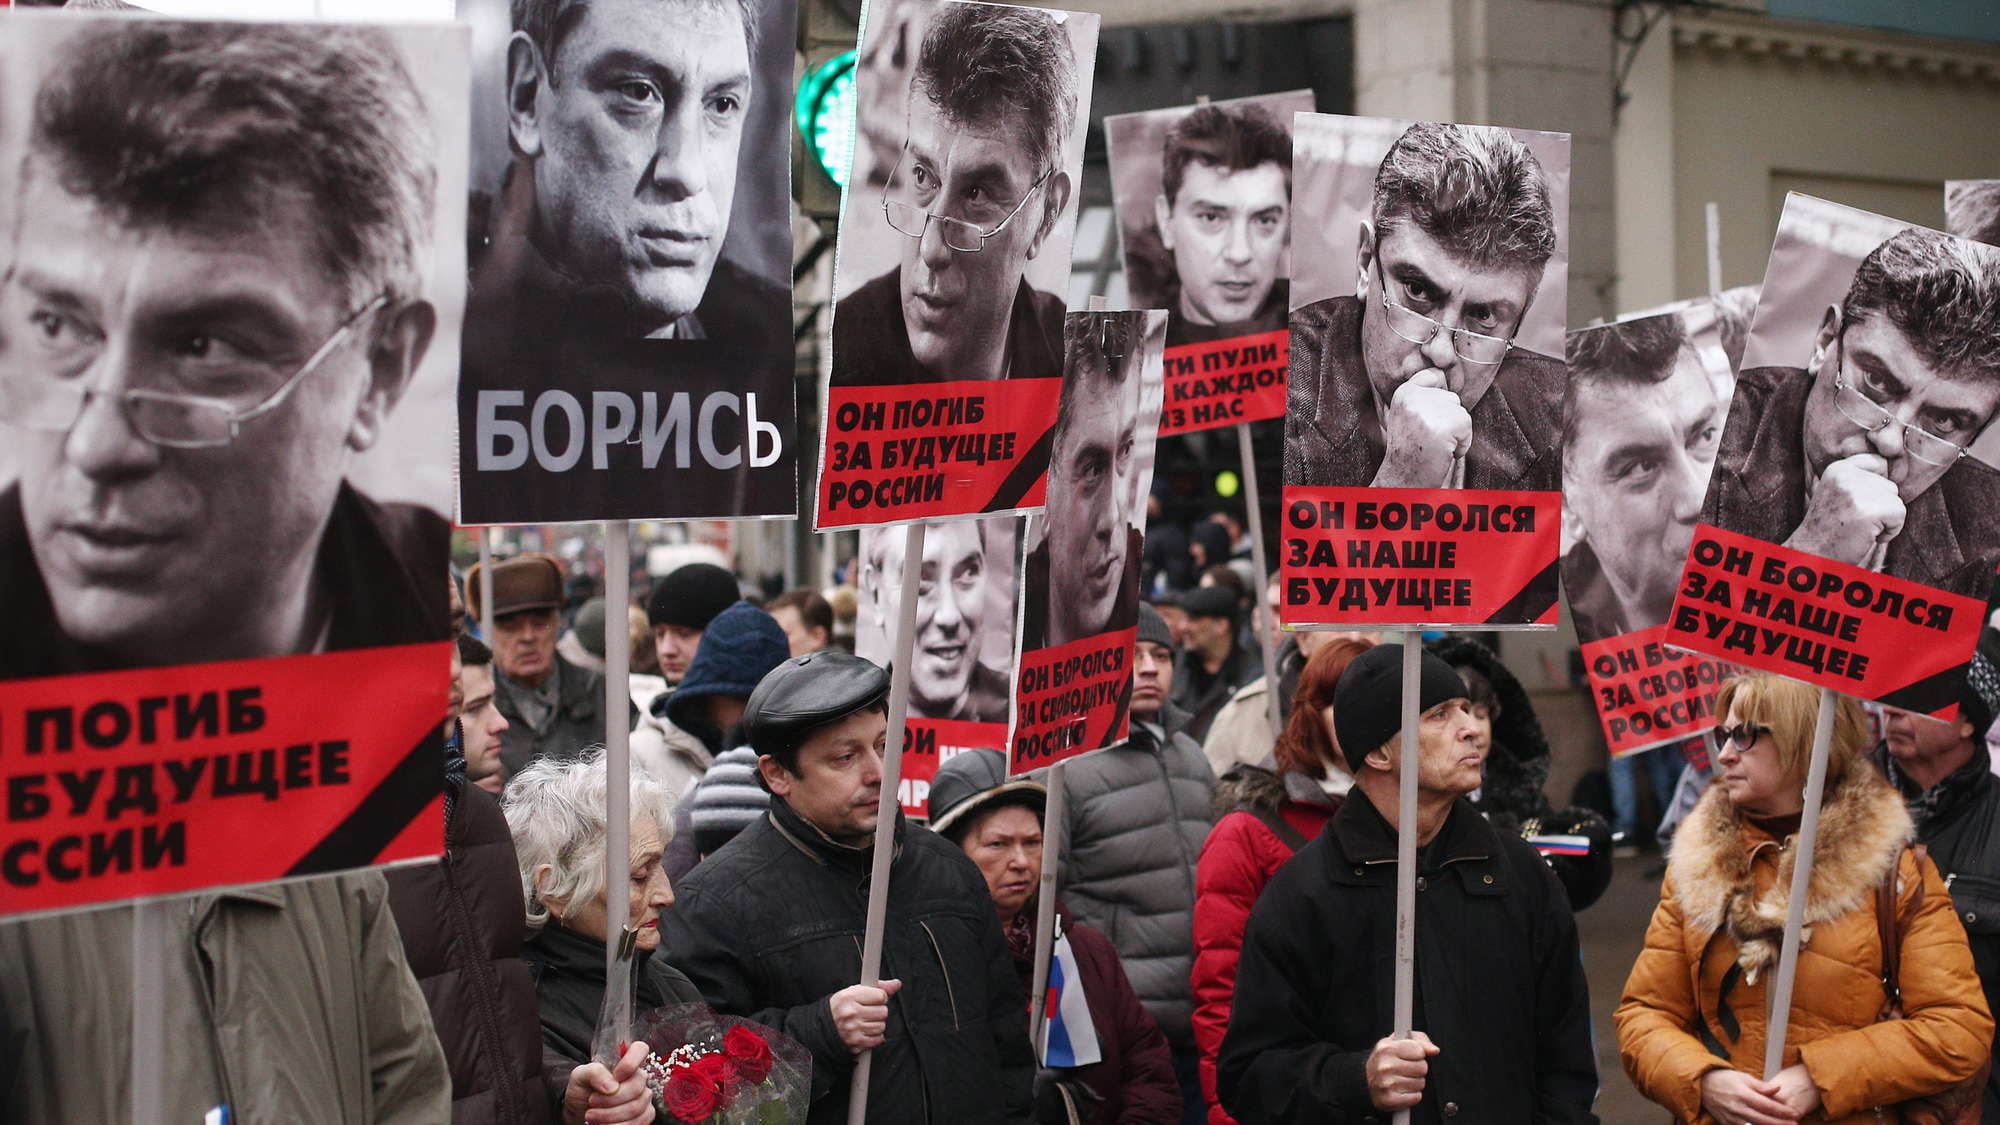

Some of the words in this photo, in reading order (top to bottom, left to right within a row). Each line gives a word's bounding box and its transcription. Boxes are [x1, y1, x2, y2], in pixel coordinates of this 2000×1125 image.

[1202, 344, 1277, 371] ПУЛИ
[836, 402, 886, 432] ОН
[893, 397, 985, 429] ПОГИБ
[1192, 400, 1243, 423] НАС
[476, 390, 782, 472] БОРИСЬ
[832, 442, 872, 471] ЗА
[881, 432, 1016, 470] БУДУЩЕЕ
[829, 473, 945, 510] РОССИИ
[1289, 500, 1344, 529] ОН
[1355, 502, 1535, 532] БОРОЛСЯ
[1287, 538, 1337, 567] ЗА
[1347, 540, 1456, 568] НАШЕ
[1287, 577, 1471, 611] БУДУЩЕЕ
[1694, 540, 1753, 576] ОН
[1760, 557, 1954, 632] БОРОЛСЯ
[1682, 571, 1732, 608] ЗА
[1742, 589, 1862, 643] НАШЕ
[1674, 605, 1870, 681] БУДУЩЕЕ
[1022, 665, 1048, 693] ОН
[1053, 647, 1124, 687] БОРОЛСЯ
[1594, 648, 1639, 678] ОН
[1021, 701, 1035, 729] ЗА
[1601, 683, 1635, 711] ЗА
[25, 686, 265, 755] ПОГИБ
[7, 740, 350, 823] БУДУЩЕЕ
[2, 821, 186, 887] ССИИ
